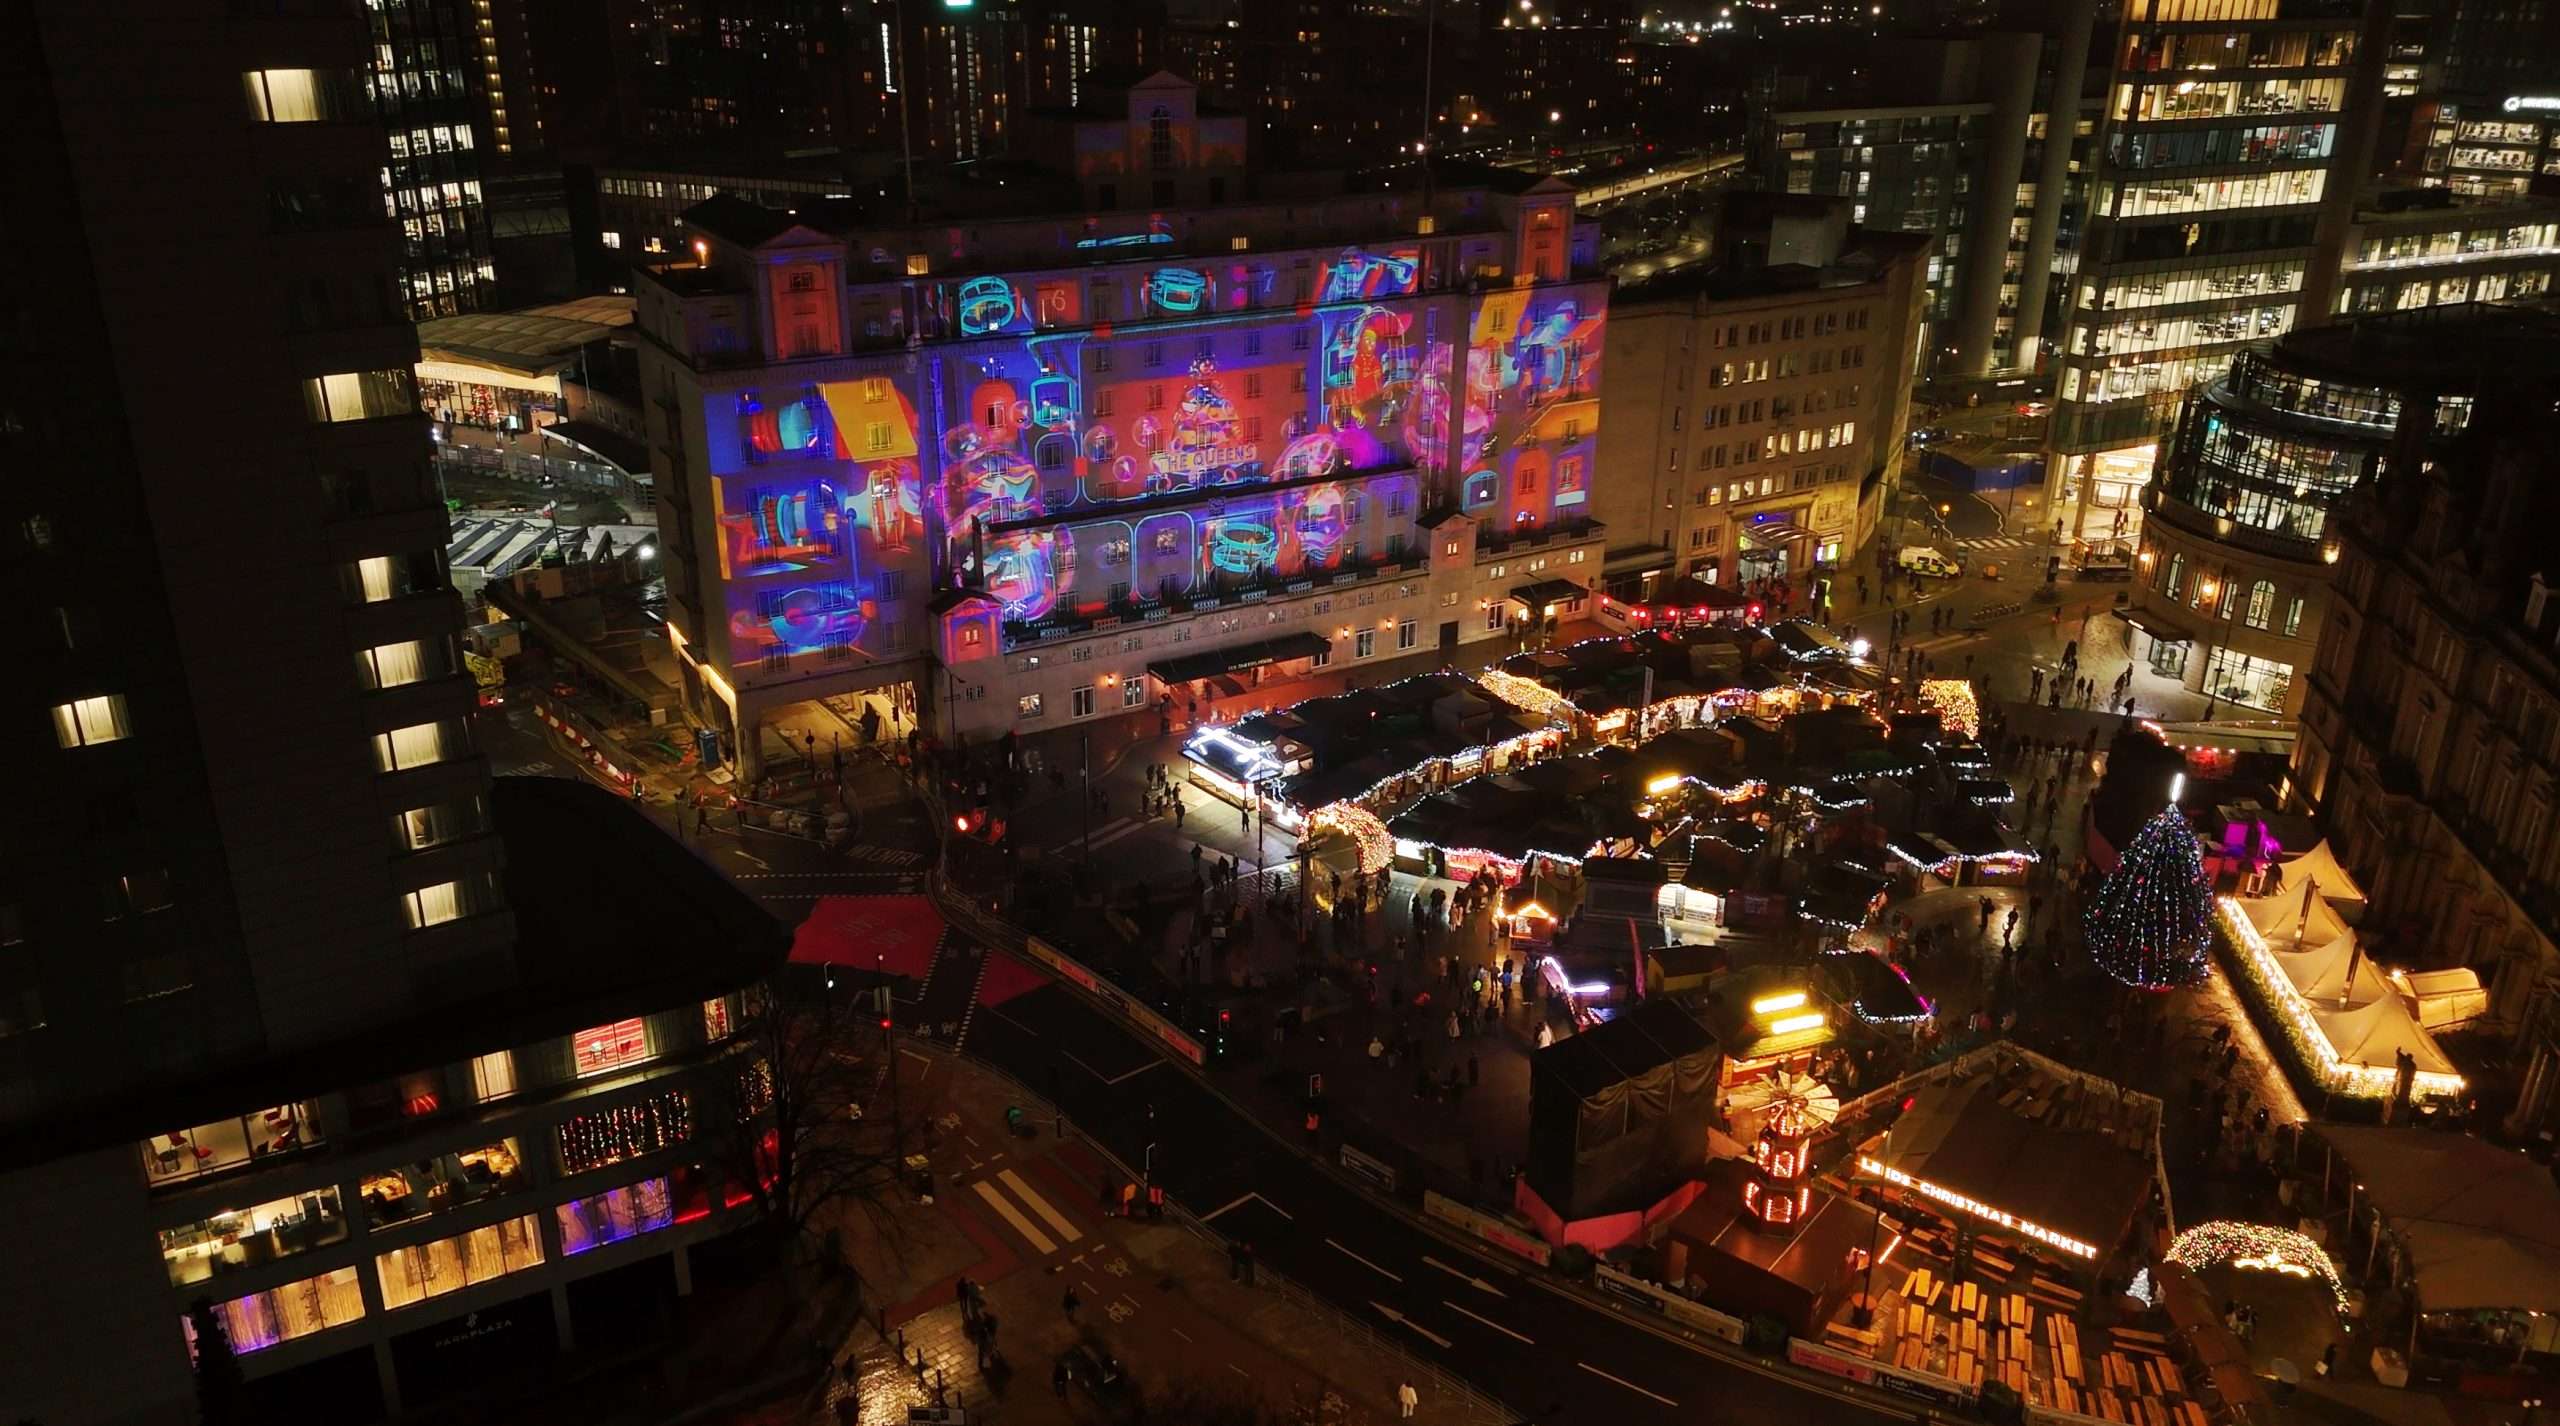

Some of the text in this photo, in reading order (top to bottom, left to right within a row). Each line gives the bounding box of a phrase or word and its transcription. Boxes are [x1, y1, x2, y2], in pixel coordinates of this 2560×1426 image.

[1156, 443, 1257, 473] THE QUEENS
[1919, 1182, 2013, 1227] CHRISTMAS
[2020, 1219, 2097, 1260] MARKET
